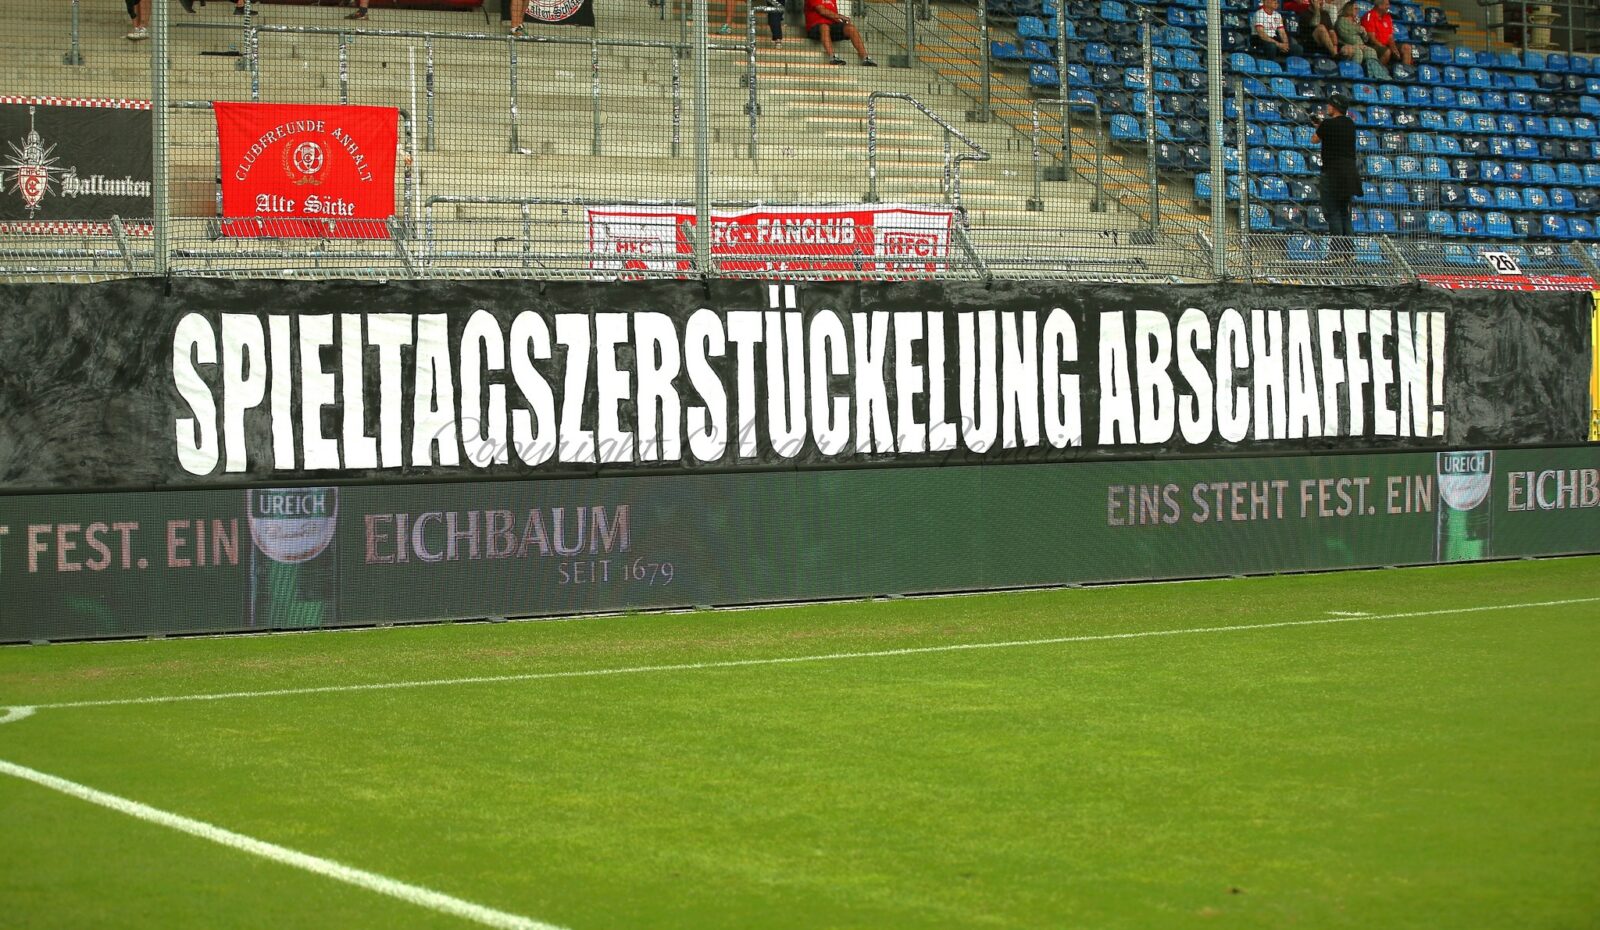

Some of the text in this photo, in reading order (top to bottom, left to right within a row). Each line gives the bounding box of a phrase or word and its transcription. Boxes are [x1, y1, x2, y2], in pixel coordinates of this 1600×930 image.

[235, 121, 374, 183] CLUBFREUNDE ANHALT
[255, 193, 356, 216] Alte Säcke
[757, 217, 855, 245] FANCLUB
[889, 237, 930, 257] HFC
[1490, 254, 1516, 271] 26
[173, 284, 1446, 475] SPIELTAGSZERSTÜCKELUNG ABSCHAFFEN!
[1444, 455, 1486, 473] UREICH
[260, 494, 326, 515] UREICH
[1107, 474, 1432, 526] EINS STEHT FEST. EIN
[1507, 468, 1600, 512] EICHB
[26, 518, 239, 573] FEST. EIN
[364, 504, 632, 565] EICHBAUM
[558, 555, 675, 587] SEIT 1679
